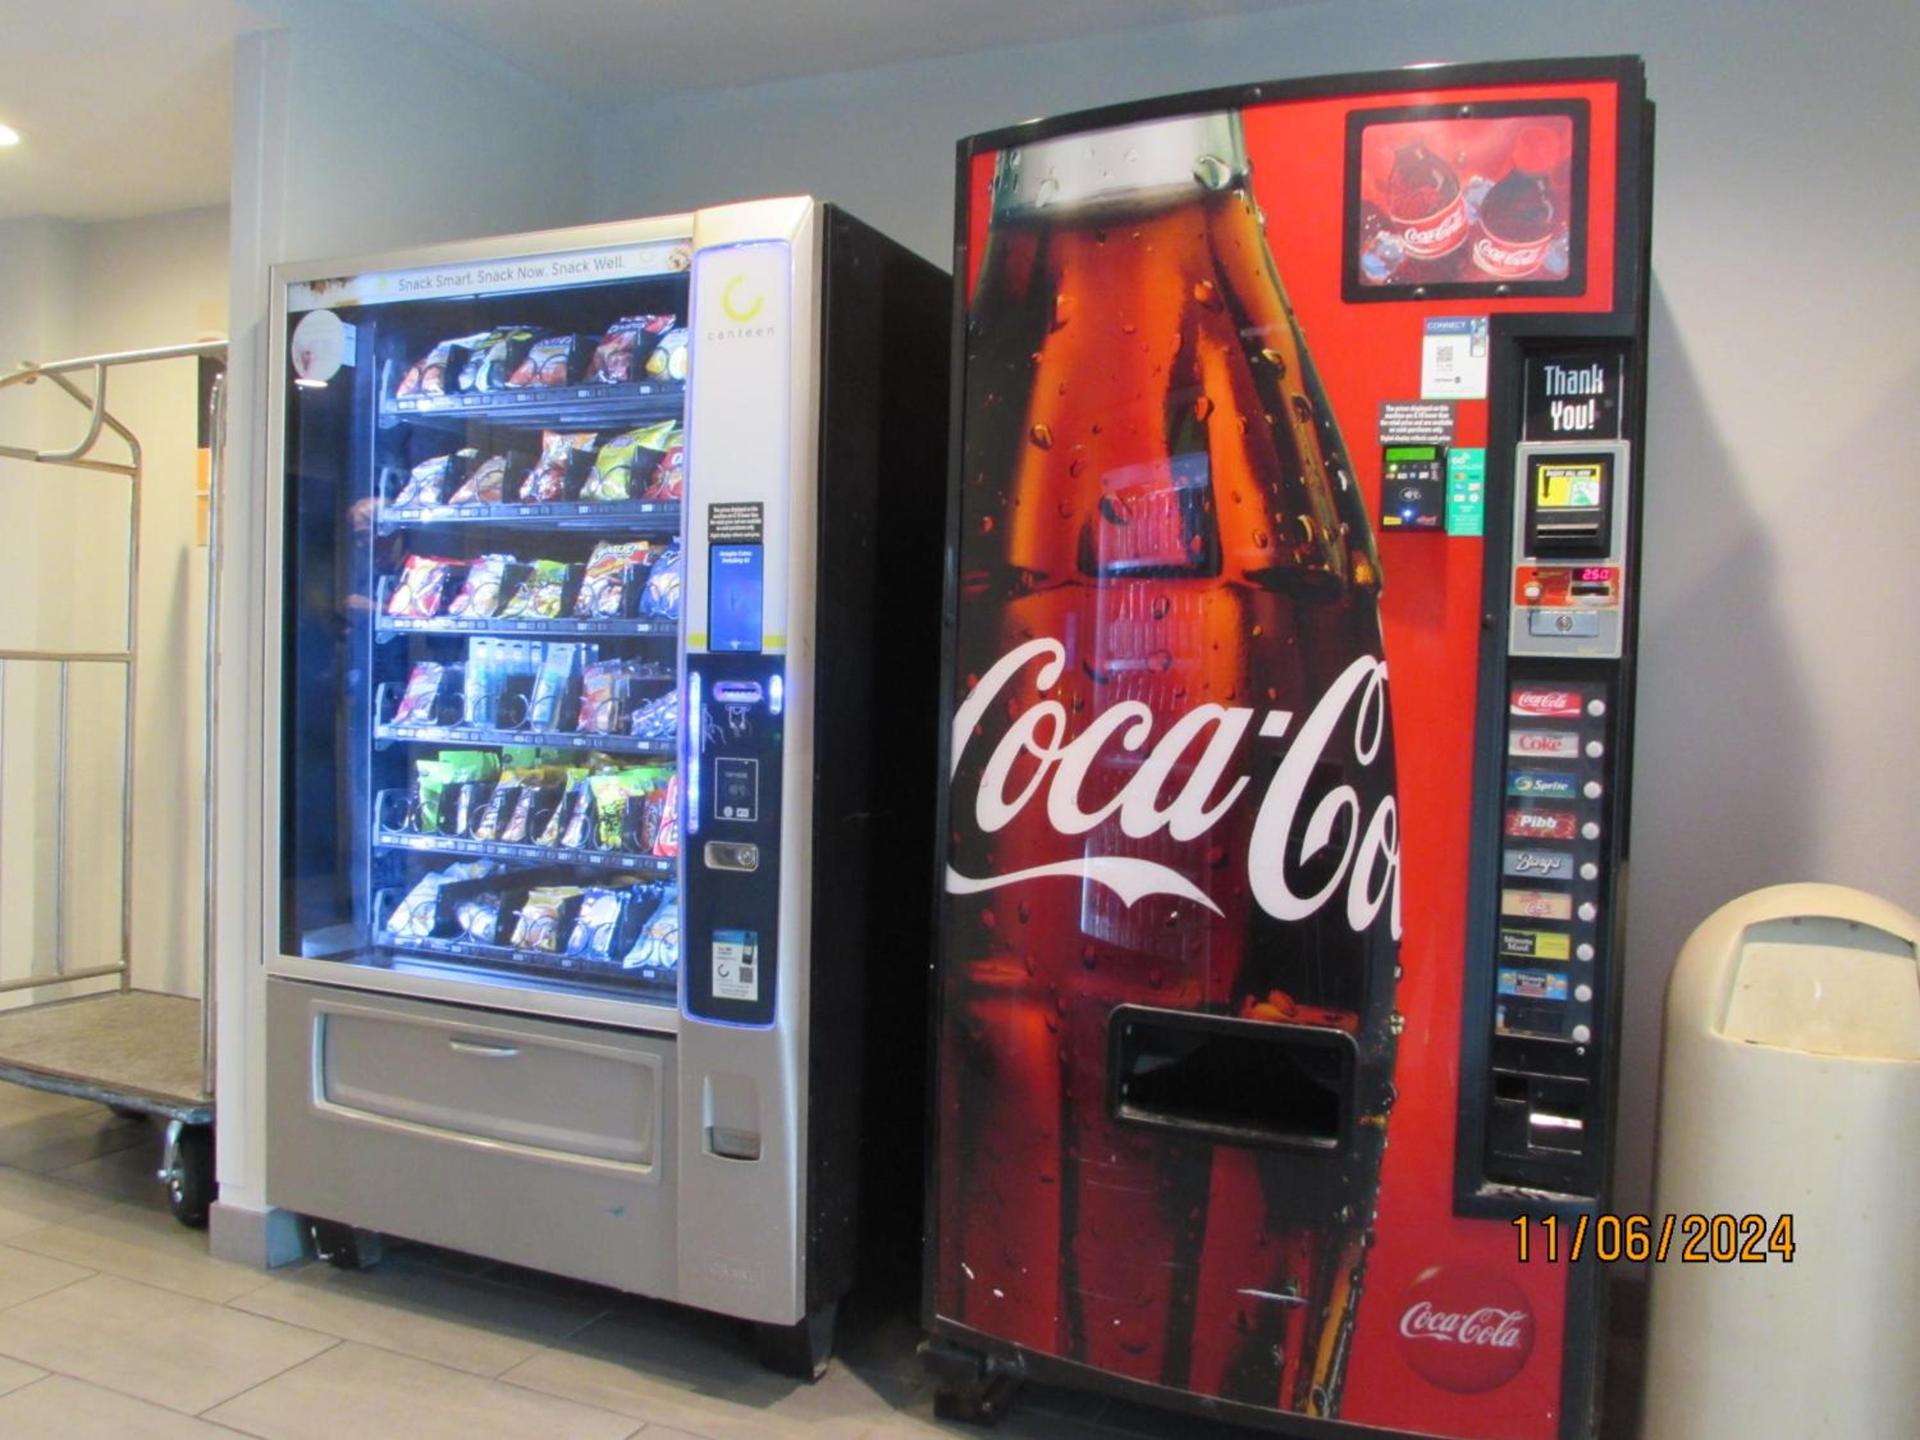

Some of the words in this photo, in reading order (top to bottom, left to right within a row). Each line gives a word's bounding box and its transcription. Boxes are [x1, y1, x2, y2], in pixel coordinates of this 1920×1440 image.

[399, 276, 432, 292] Snack
[436, 272, 472, 289] Smart.
[477, 269, 514, 285] Snack
[552, 261, 589, 277] Snack
[707, 327, 775, 341] canteen
[1544, 363, 1604, 396] Thank
[1519, 735, 1563, 752] Coke
[946, 637, 1402, 941] Coca-Co
[1532, 779, 1569, 792] Sprite
[1520, 815, 1557, 829] Pibb
[1401, 1301, 1527, 1347] Coca-Cola
